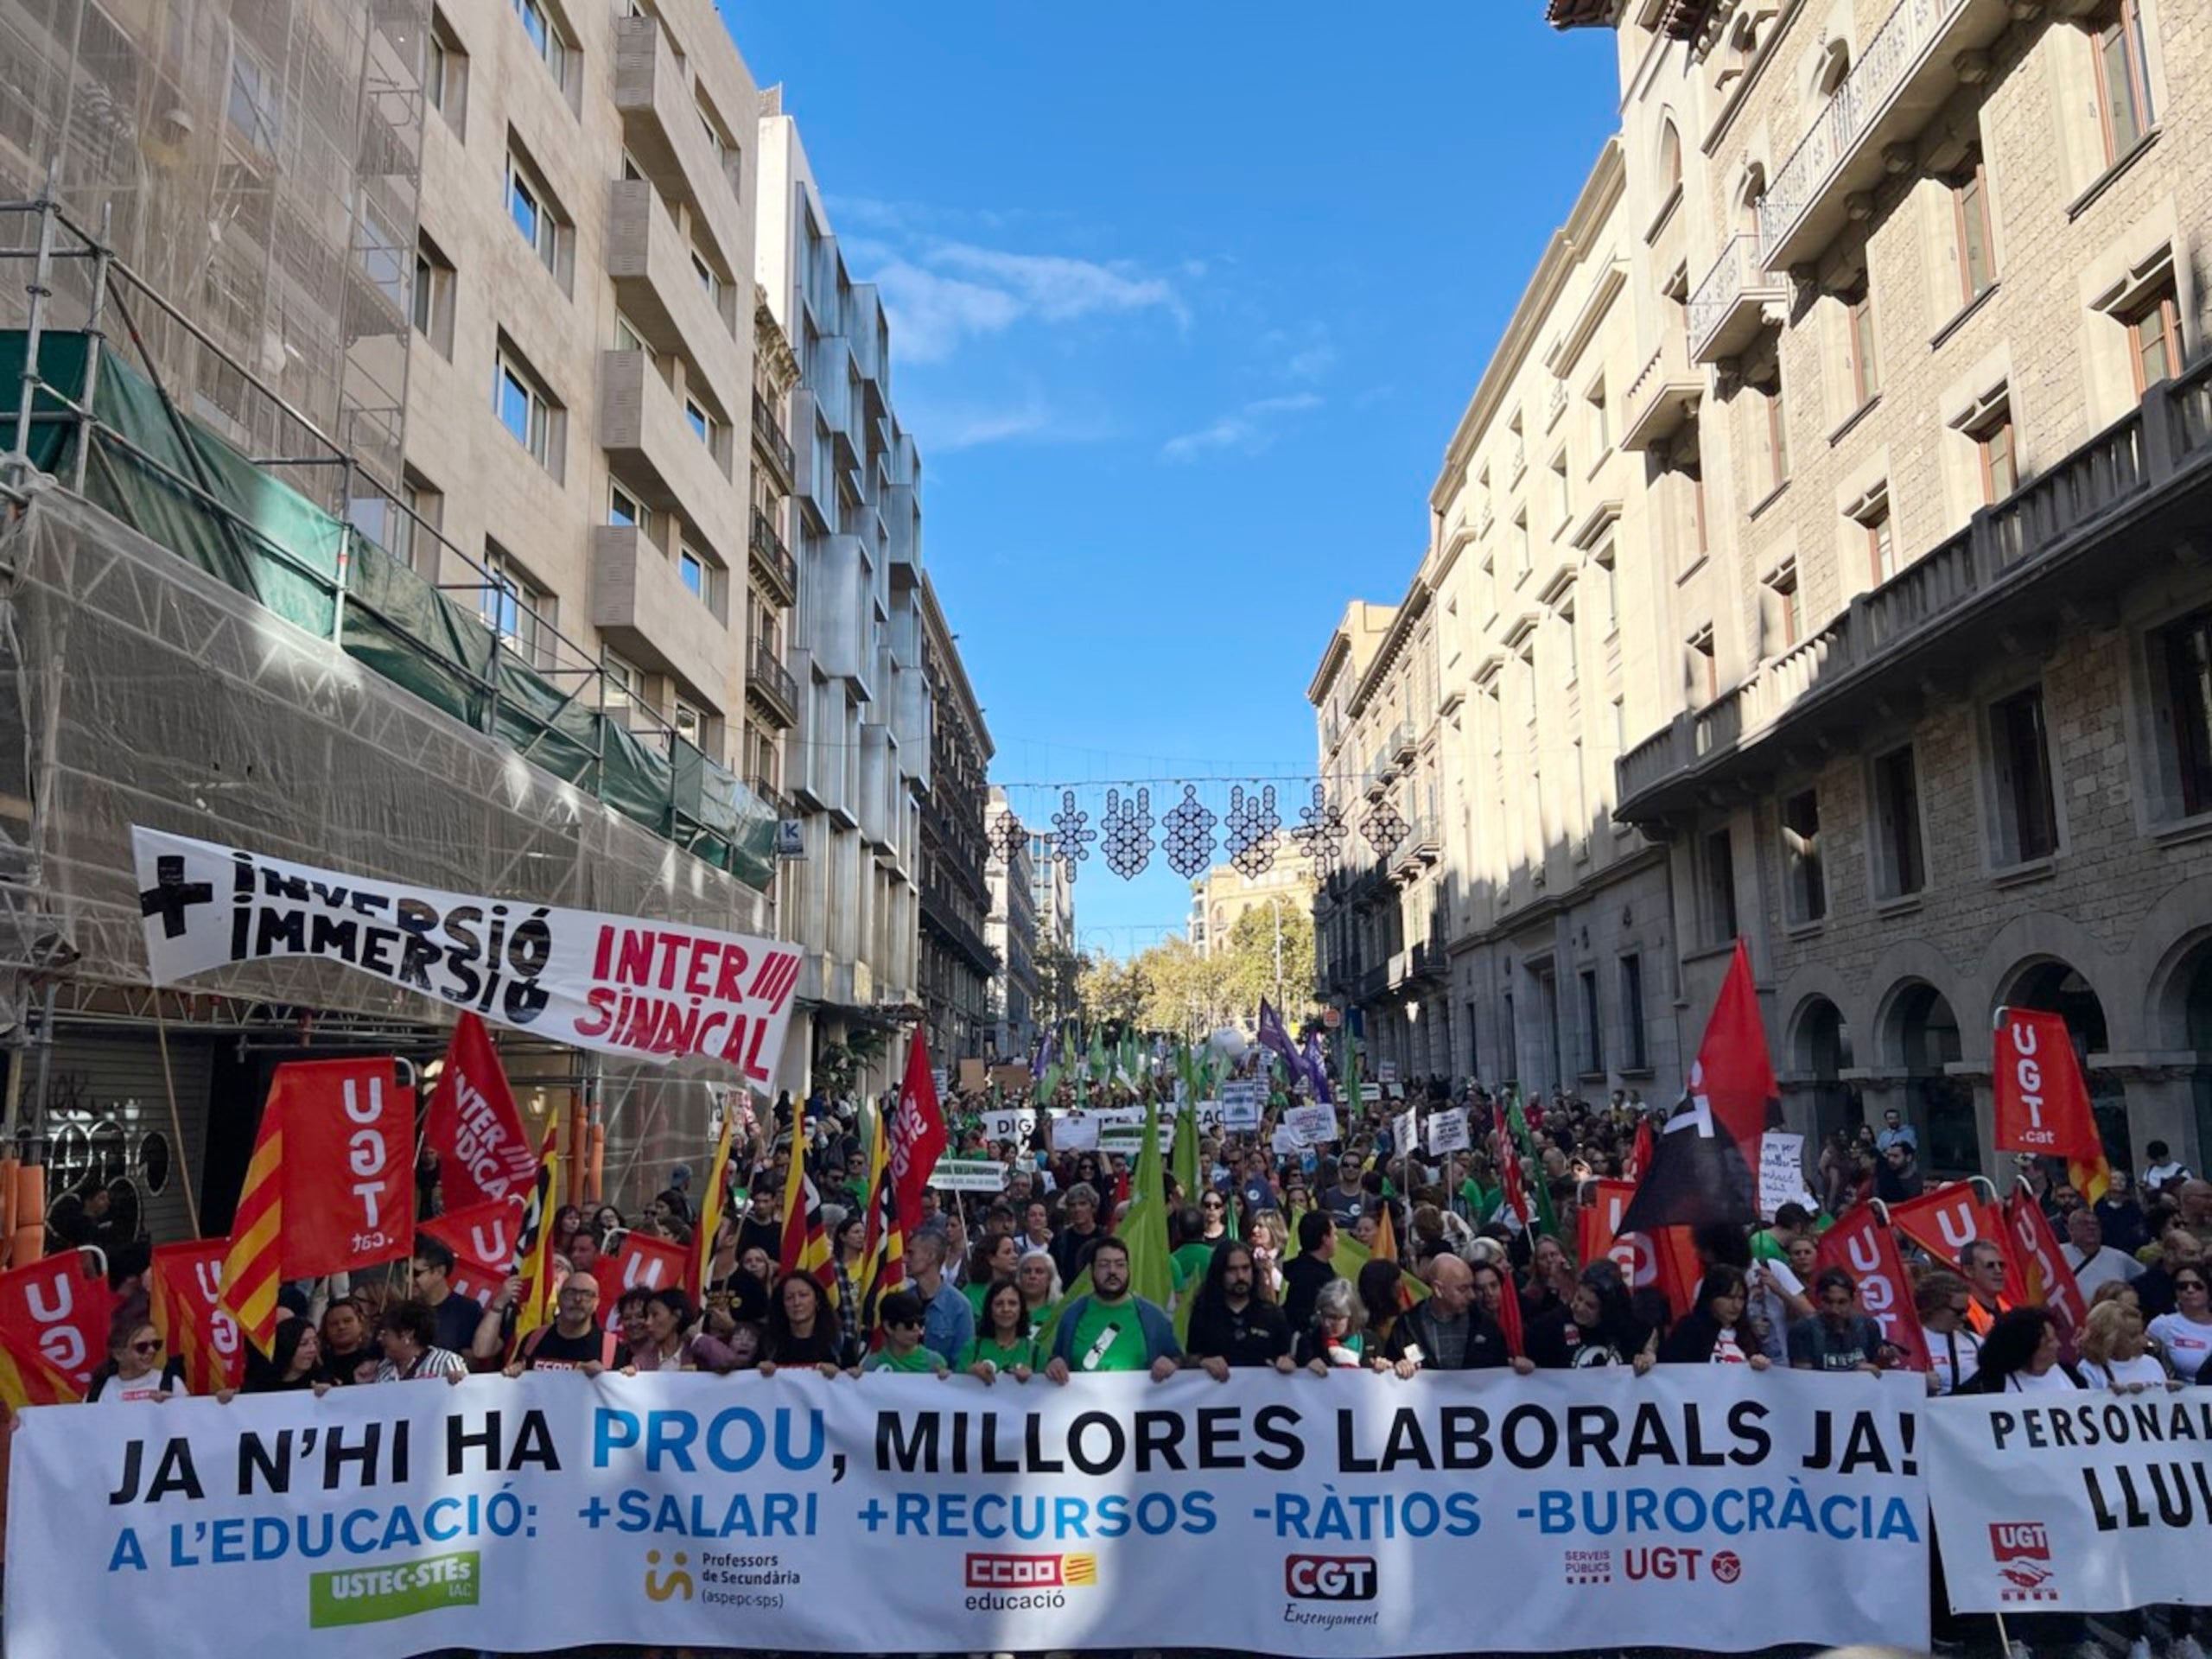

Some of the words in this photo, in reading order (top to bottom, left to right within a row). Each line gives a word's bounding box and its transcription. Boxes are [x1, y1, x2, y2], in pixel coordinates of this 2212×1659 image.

[2012, 1021, 2044, 1128] UGT
[109, 1437, 205, 1506] JA
[446, 1409, 562, 1471] HA
[591, 1406, 848, 1484] PROU,
[875, 1404, 1306, 1474] MILLORES
[1337, 1400, 1772, 1473] LABORALS
[1802, 1409, 1920, 1477] JA!
[108, 1528, 148, 1572] A
[578, 1489, 818, 1538] +SALARI
[857, 1490, 1217, 1541] +RECURSOS
[1253, 1484, 1481, 1541] -RÀTIOS
[1517, 1475, 1920, 1543] -BUROCRÀCIA
[1998, 1525, 2047, 1548] UGT
[702, 1552, 778, 1567] Professors
[1565, 1549, 1611, 1561] SERVEIS
[1624, 1546, 1703, 1581] UGT
[702, 1569, 717, 1583] de
[721, 1570, 801, 1586] Secundària
[971, 1560, 1056, 1583] CCOO
[1289, 1559, 1373, 1598] CGT
[1565, 1560, 1611, 1574] PÚBLICS
[965, 1589, 1065, 1611] educació
[1283, 1603, 1379, 1631] Ensenyament
